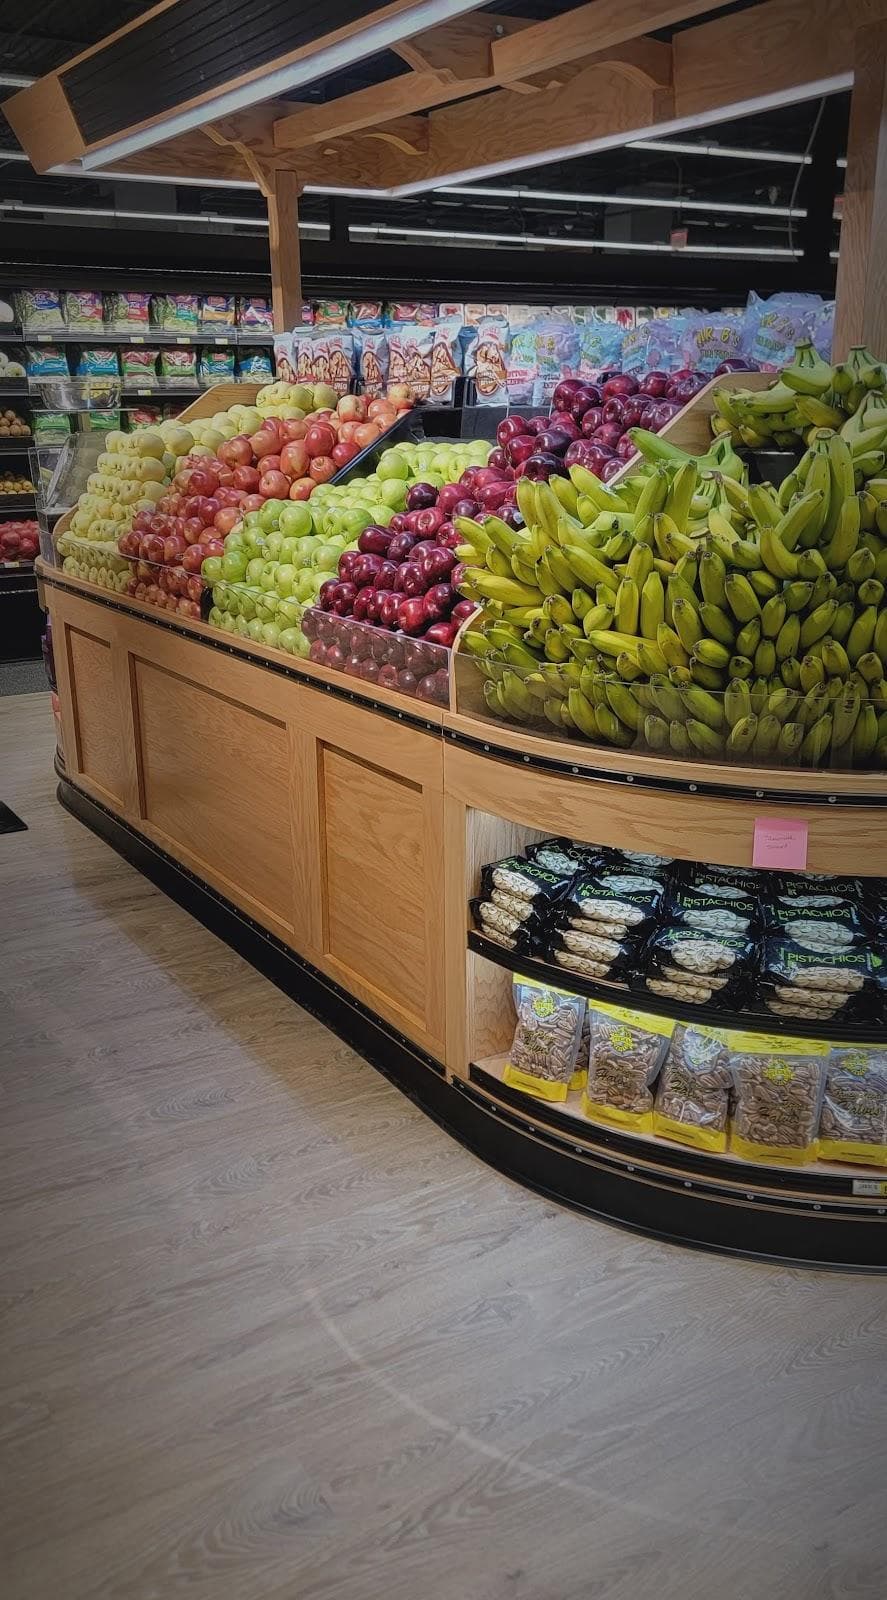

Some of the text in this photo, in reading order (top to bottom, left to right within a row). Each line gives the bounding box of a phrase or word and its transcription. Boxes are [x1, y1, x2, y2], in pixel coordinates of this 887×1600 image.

[786, 881, 855, 893] PISTACHIOS
[684, 896, 754, 911] PISTACHIOS
[777, 908, 851, 919] PISTACHIOS
[787, 952, 866, 965] PISTACHIOS
